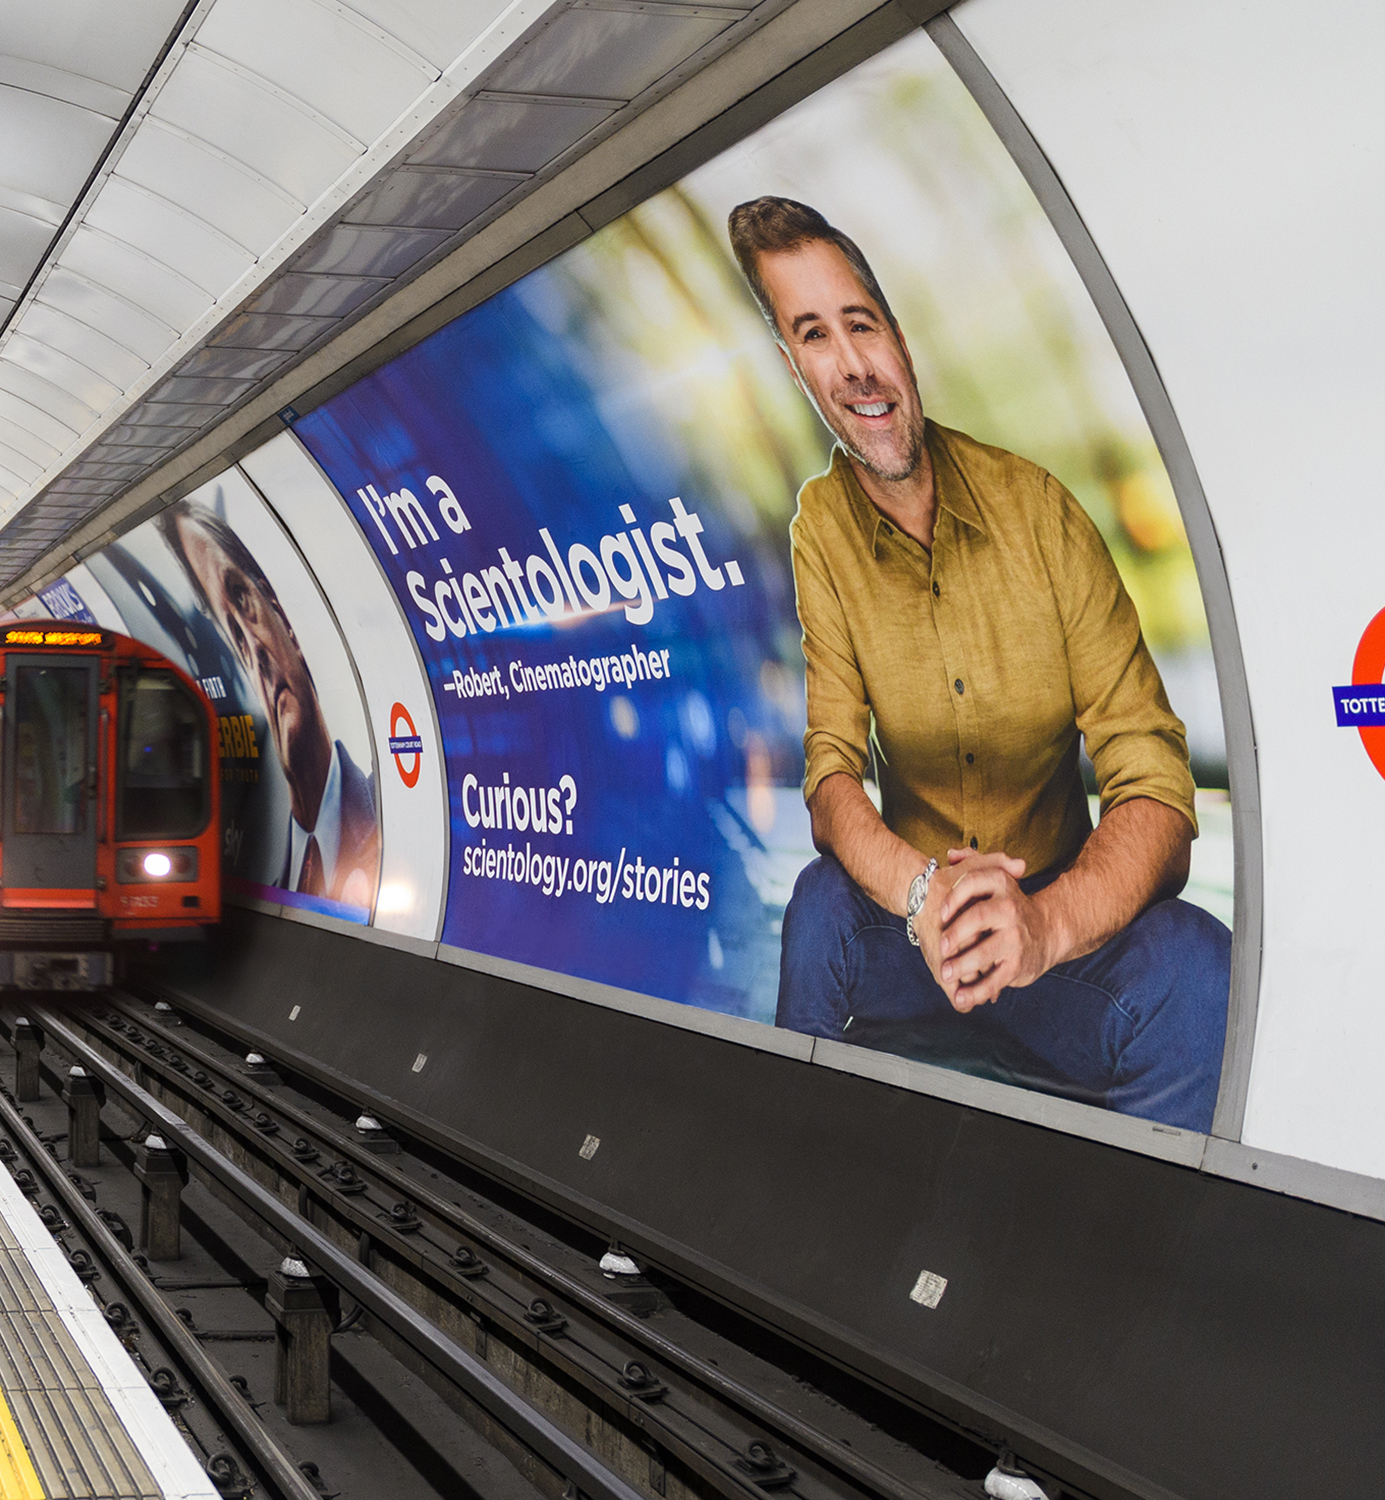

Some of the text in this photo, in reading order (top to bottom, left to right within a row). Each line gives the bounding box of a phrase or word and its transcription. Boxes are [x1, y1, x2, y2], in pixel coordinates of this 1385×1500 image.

[357, 475, 472, 555] I'm a
[406, 497, 745, 642] Scientologist.
[509, 644, 671, 693] Cinematographer
[1340, 697, 1385, 714] TOTTE
[462, 772, 577, 835] Curious?
[464, 838, 710, 910] scientology.org/stories
